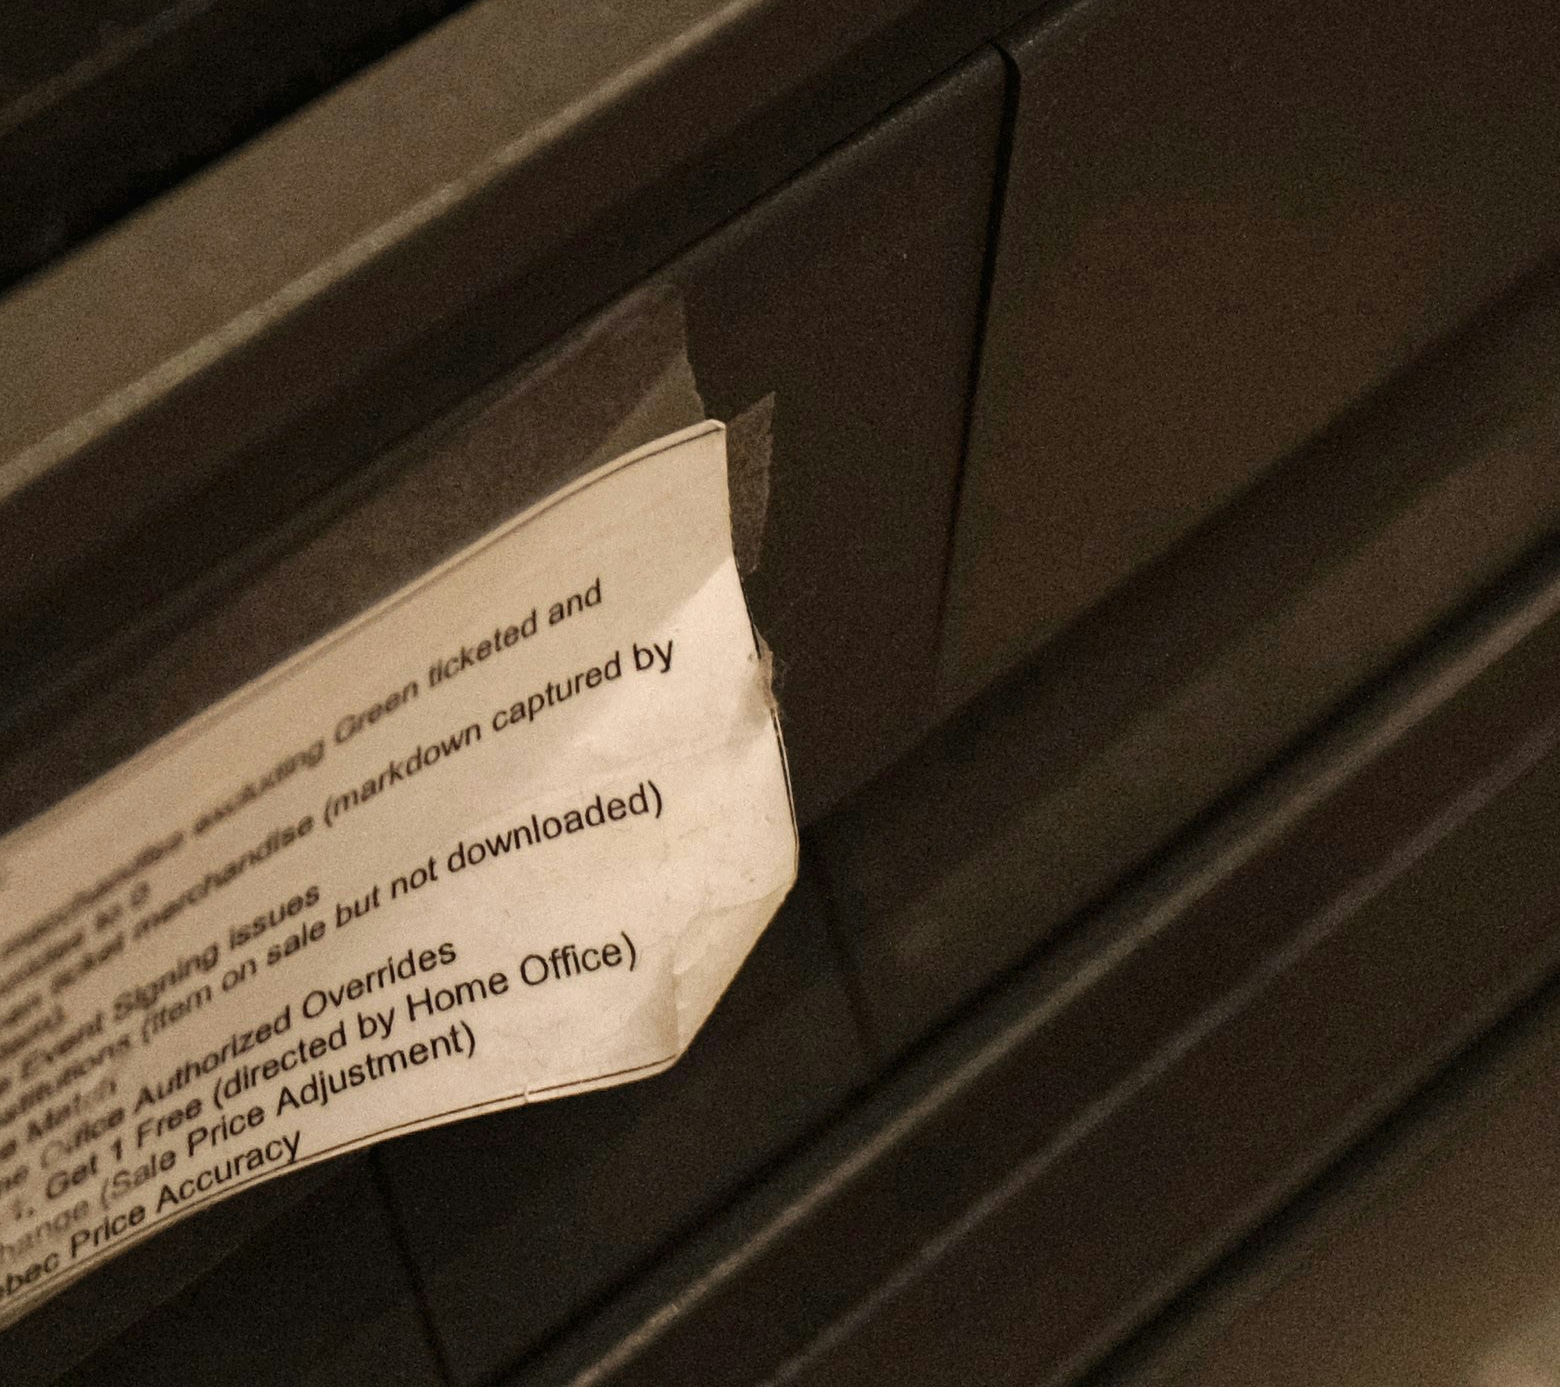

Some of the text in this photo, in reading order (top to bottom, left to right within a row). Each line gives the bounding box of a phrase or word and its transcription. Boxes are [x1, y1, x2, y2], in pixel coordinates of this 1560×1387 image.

[334, 680, 420, 747] Green
[428, 609, 539, 688] ticketed
[547, 577, 604, 625] and
[132, 814, 316, 939] merchandise
[322, 722, 482, 829] (markdown
[490, 650, 622, 734] captured
[631, 639, 675, 675] by
[111, 940, 220, 1023] Signing
[228, 883, 321, 951] issues
[139, 984, 214, 1046] (item
[221, 958, 258, 994] on
[266, 922, 327, 968] sale
[334, 884, 382, 930] but
[390, 856, 440, 902] not
[446, 779, 664, 874] downloaded)
[44, 1156, 100, 1202] Get
[109, 1136, 125, 1162] 1
[134, 1097, 203, 1149] Free
[212, 1021, 347, 1111] (directed
[357, 1006, 396, 1041] by
[406, 970, 510, 1023] Home
[519, 930, 638, 988] Office)
[99, 1147, 178, 1213] (Sale
[186, 1105, 267, 1159] Price
[275, 1019, 477, 1117] Adjustment)
[133, 1003, 292, 1114] Authorized
[301, 940, 458, 1020] Overrides
[68, 1204, 147, 1259] Price
[155, 1129, 302, 1215] Accuracy
